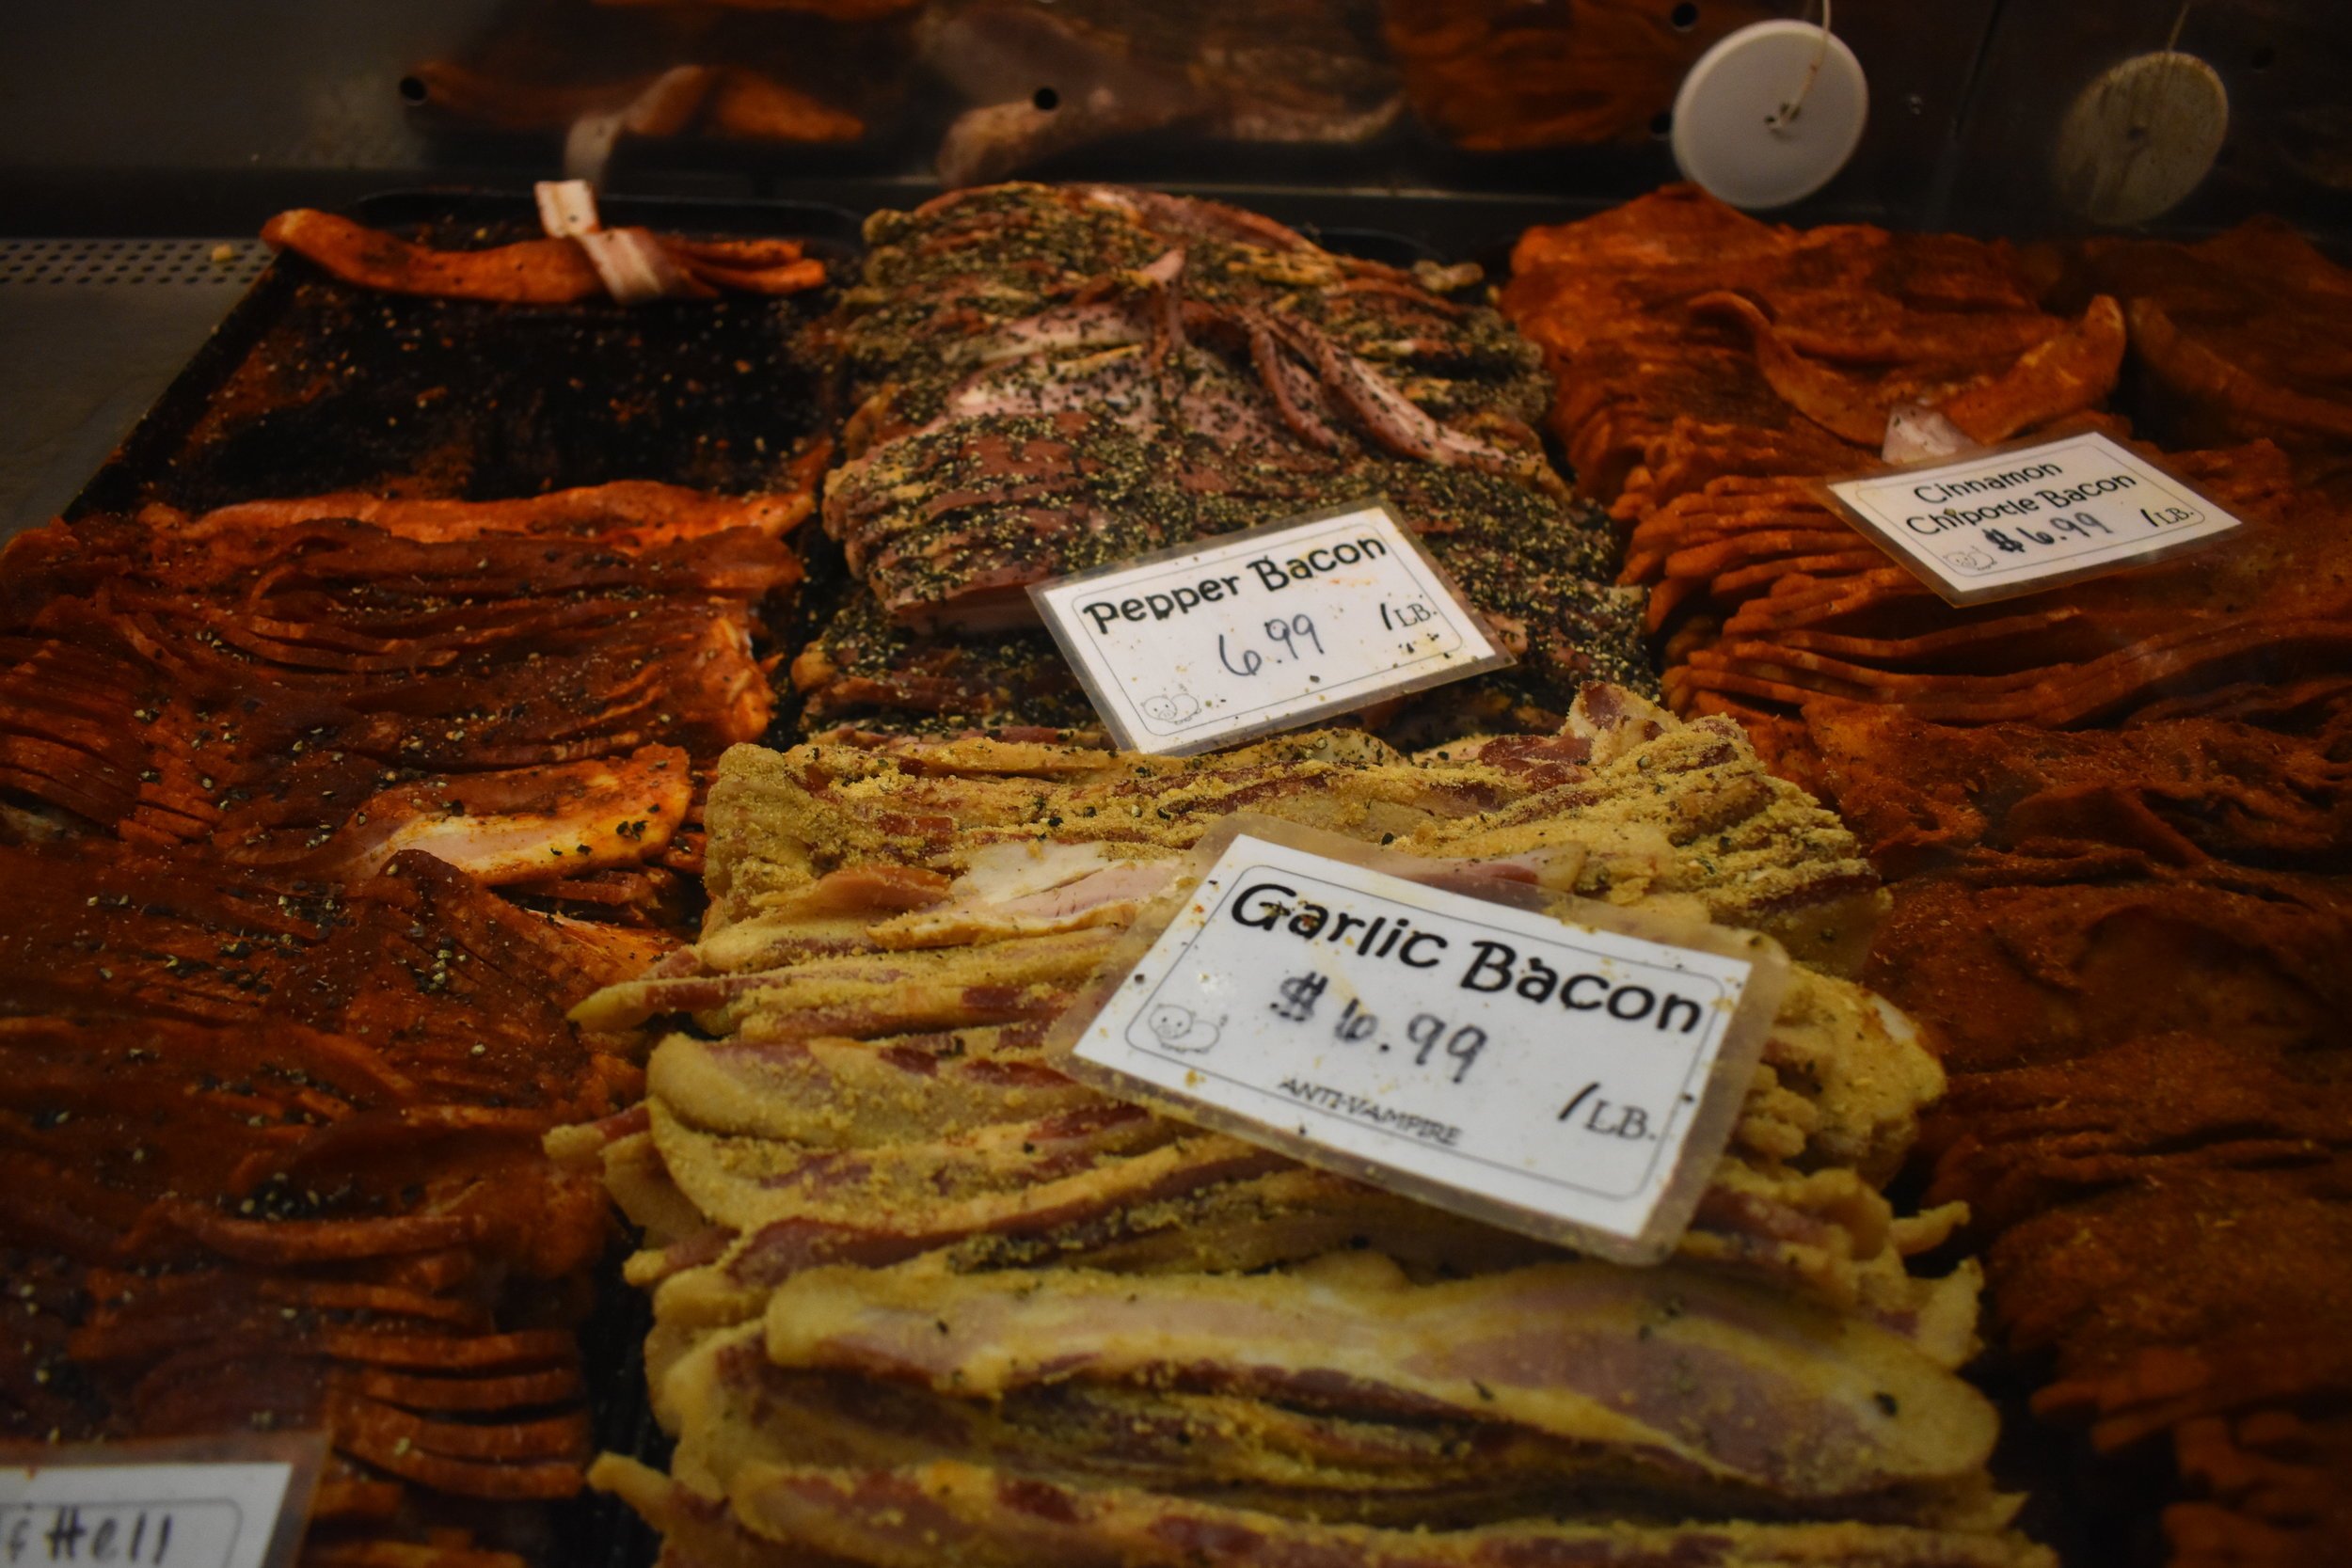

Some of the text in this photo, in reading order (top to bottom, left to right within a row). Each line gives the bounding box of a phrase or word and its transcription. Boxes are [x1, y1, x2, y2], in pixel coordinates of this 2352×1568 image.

[1905, 472, 2137, 535] Chipotle Bacon
[1913, 460, 2063, 504] Cinnamon
[2139, 506, 2195, 528] /LB.
[1082, 536, 1388, 635] Pepper Bacon
[1217, 602, 1438, 676] 6.99 /LB.
[1230, 882, 1703, 1035] Garlic Bacon
[1279, 1078, 1463, 1147] ANTI-VAMPIRE
[1557, 1082, 1658, 1142] /LB.
[44, 1505, 173, 1566] Hell
